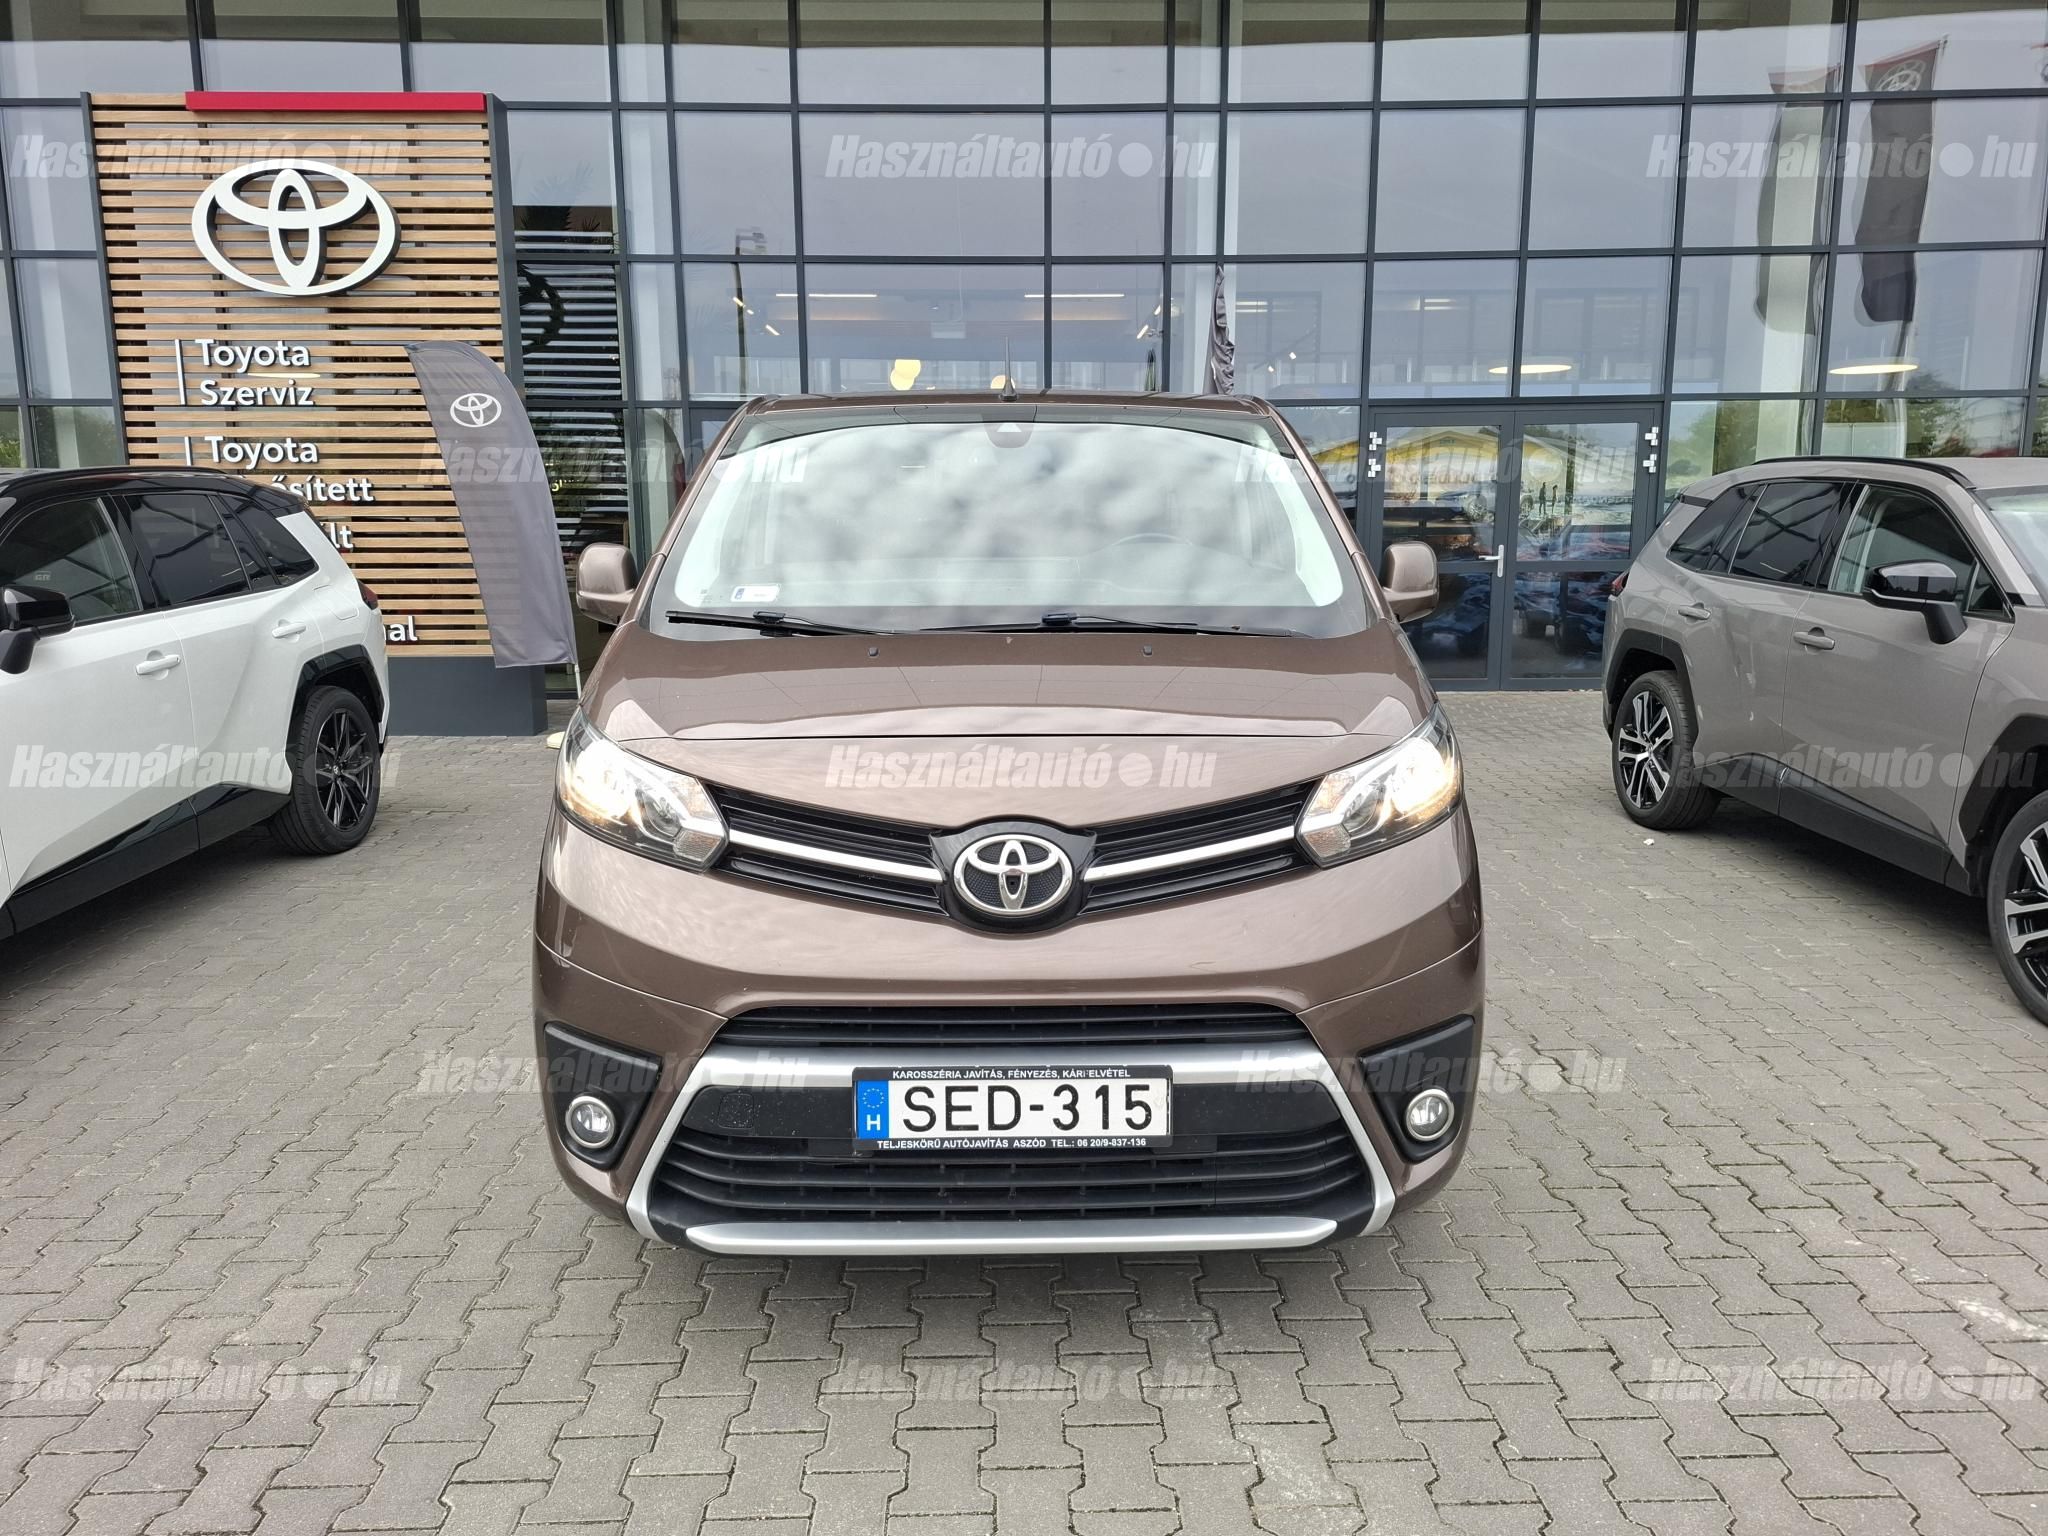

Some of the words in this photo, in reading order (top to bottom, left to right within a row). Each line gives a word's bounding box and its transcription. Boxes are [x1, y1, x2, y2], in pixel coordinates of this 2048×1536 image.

[195, 339, 311, 373] Toyota
[200, 379, 315, 406] Szerviz
[204, 436, 318, 470] Toyota
[270, 474, 374, 501] ősített
[892, 1069, 962, 1079] KAROSSZÉRIA
[963, 1068, 1006, 1080] JAVÍTÁS,
[1007, 1068, 1060, 1079] FÉNYEZÉS,
[903, 1084, 1152, 1132] SED-315
[866, 1114, 881, 1131] H
[942, 1138, 1009, 1149] AUTÓJAVÍTÁS
[1013, 1137, 1046, 1148] ASZÓD
[1051, 1139, 1075, 1148] TEL.:
[1077, 1138, 1088, 1147] 06
